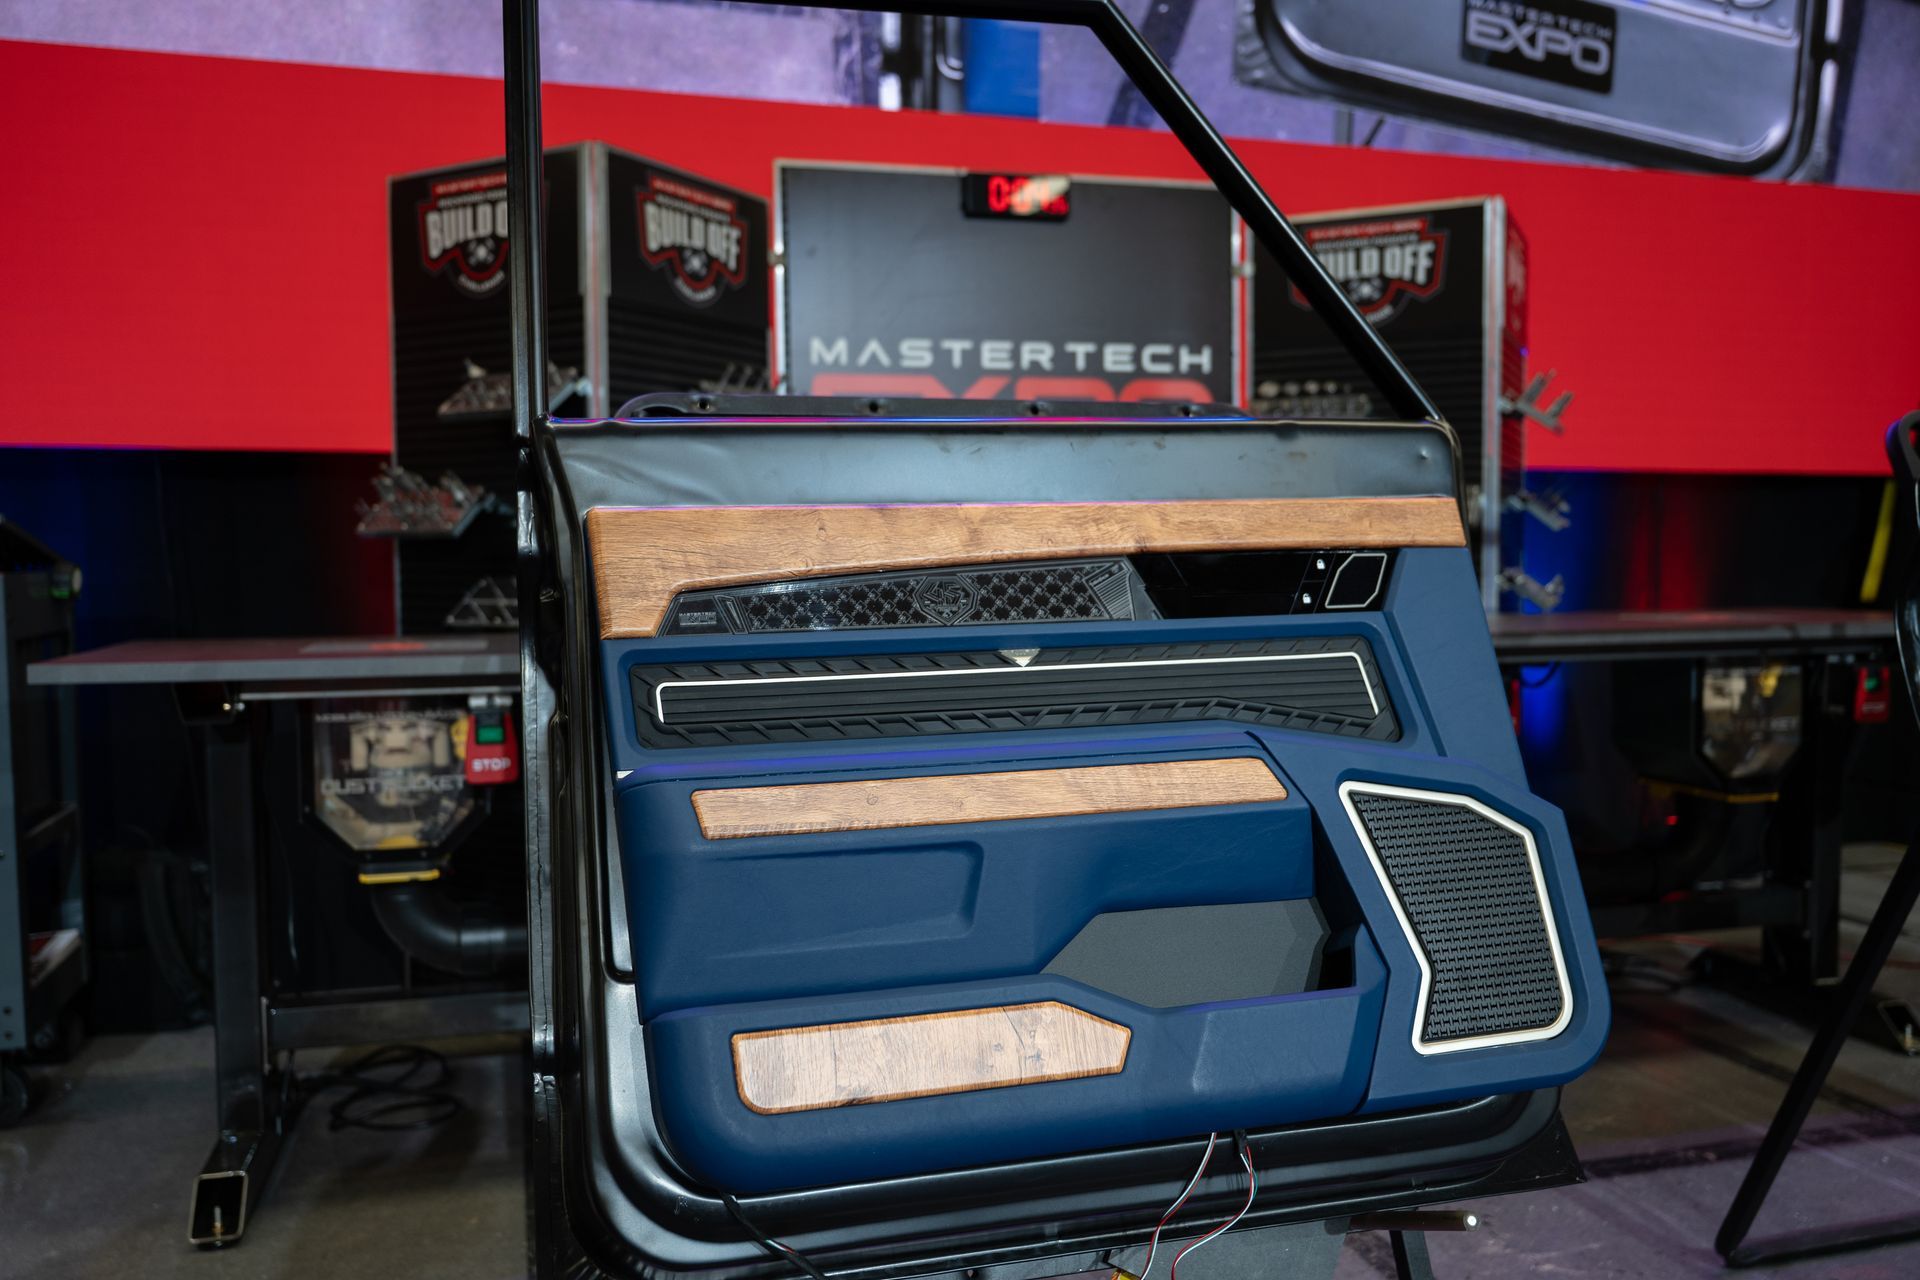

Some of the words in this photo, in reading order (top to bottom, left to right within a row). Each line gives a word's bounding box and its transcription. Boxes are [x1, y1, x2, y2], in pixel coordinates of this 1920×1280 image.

[1466, 10, 1611, 75] EXPO
[426, 201, 493, 259] BUILD
[644, 201, 705, 252] BUILD
[706, 221, 741, 271] OFF
[1316, 246, 1381, 283] UILD
[1383, 241, 1436, 285] OFF
[810, 337, 1212, 375] MASTERTECH
[471, 757, 512, 772] STOP
